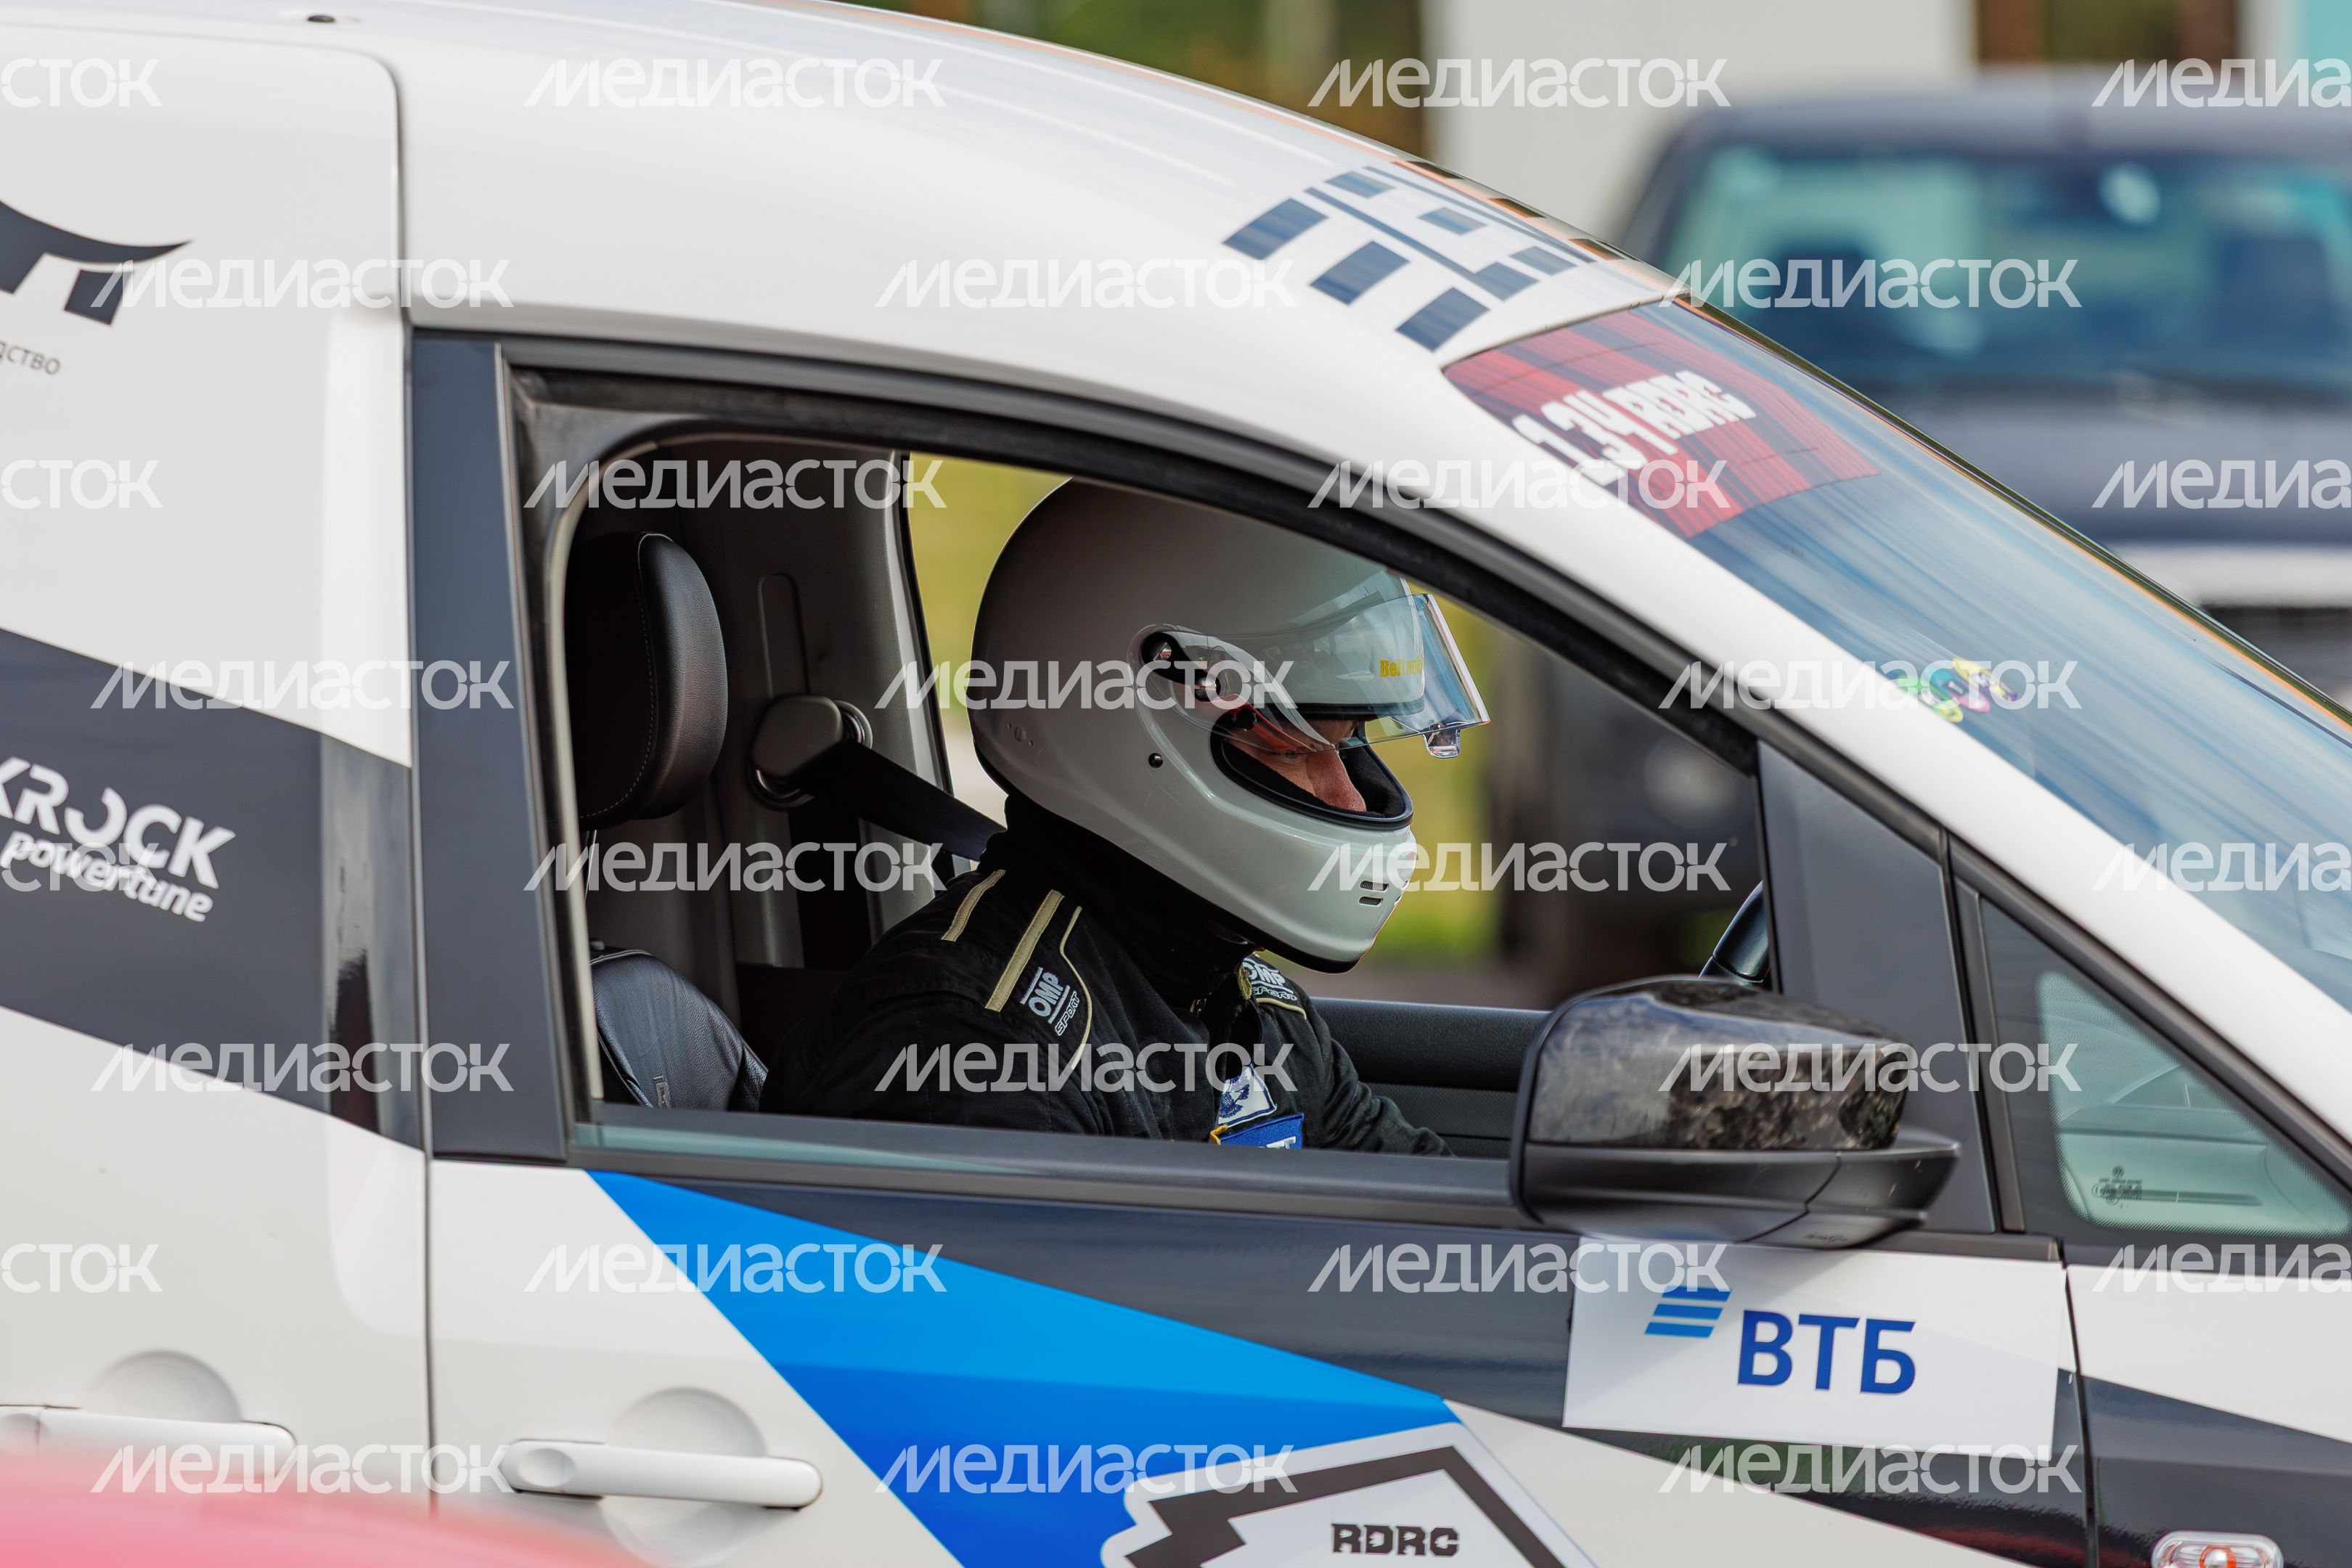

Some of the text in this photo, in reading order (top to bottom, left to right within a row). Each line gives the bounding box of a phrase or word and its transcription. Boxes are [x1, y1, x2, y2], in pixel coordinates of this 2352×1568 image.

[1242, 962, 1286, 987] OMP
[1029, 972, 1063, 1017] OMP
[1738, 1310, 1916, 1395] ВТБ
[1331, 1523, 1459, 1557] RDRC
